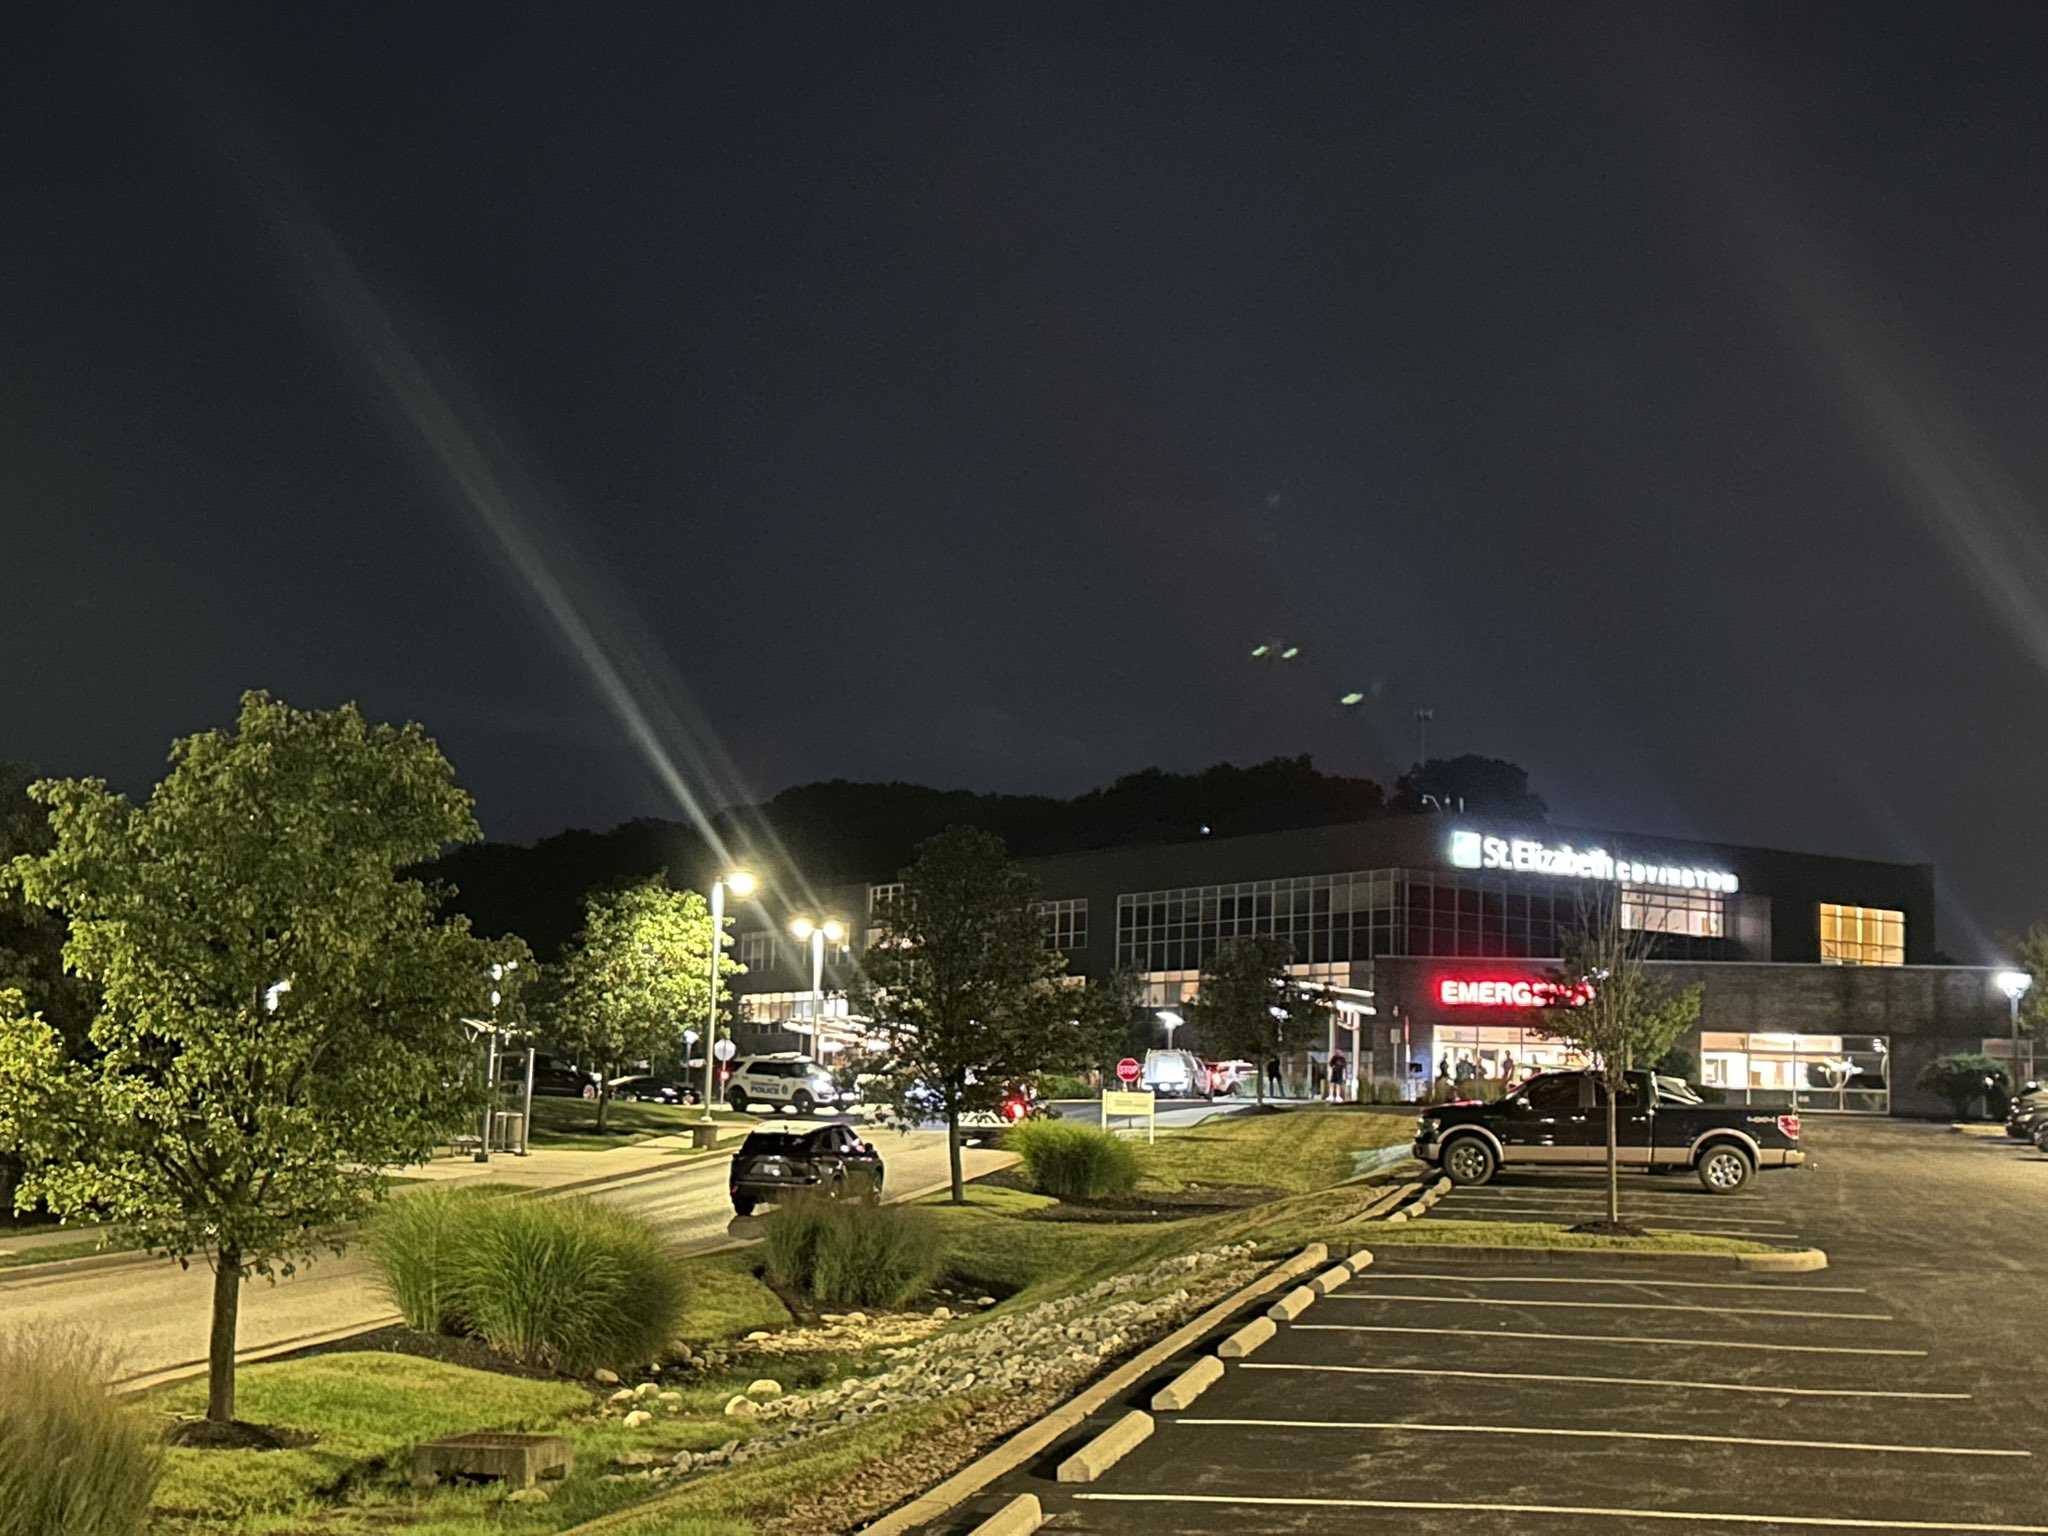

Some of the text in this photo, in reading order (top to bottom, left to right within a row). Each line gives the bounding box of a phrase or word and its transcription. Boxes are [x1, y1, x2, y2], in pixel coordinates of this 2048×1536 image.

[1441, 980, 1596, 1006] EMERGE
[1119, 1065, 1138, 1074] STOP
[751, 1086, 779, 1095] POLICE
